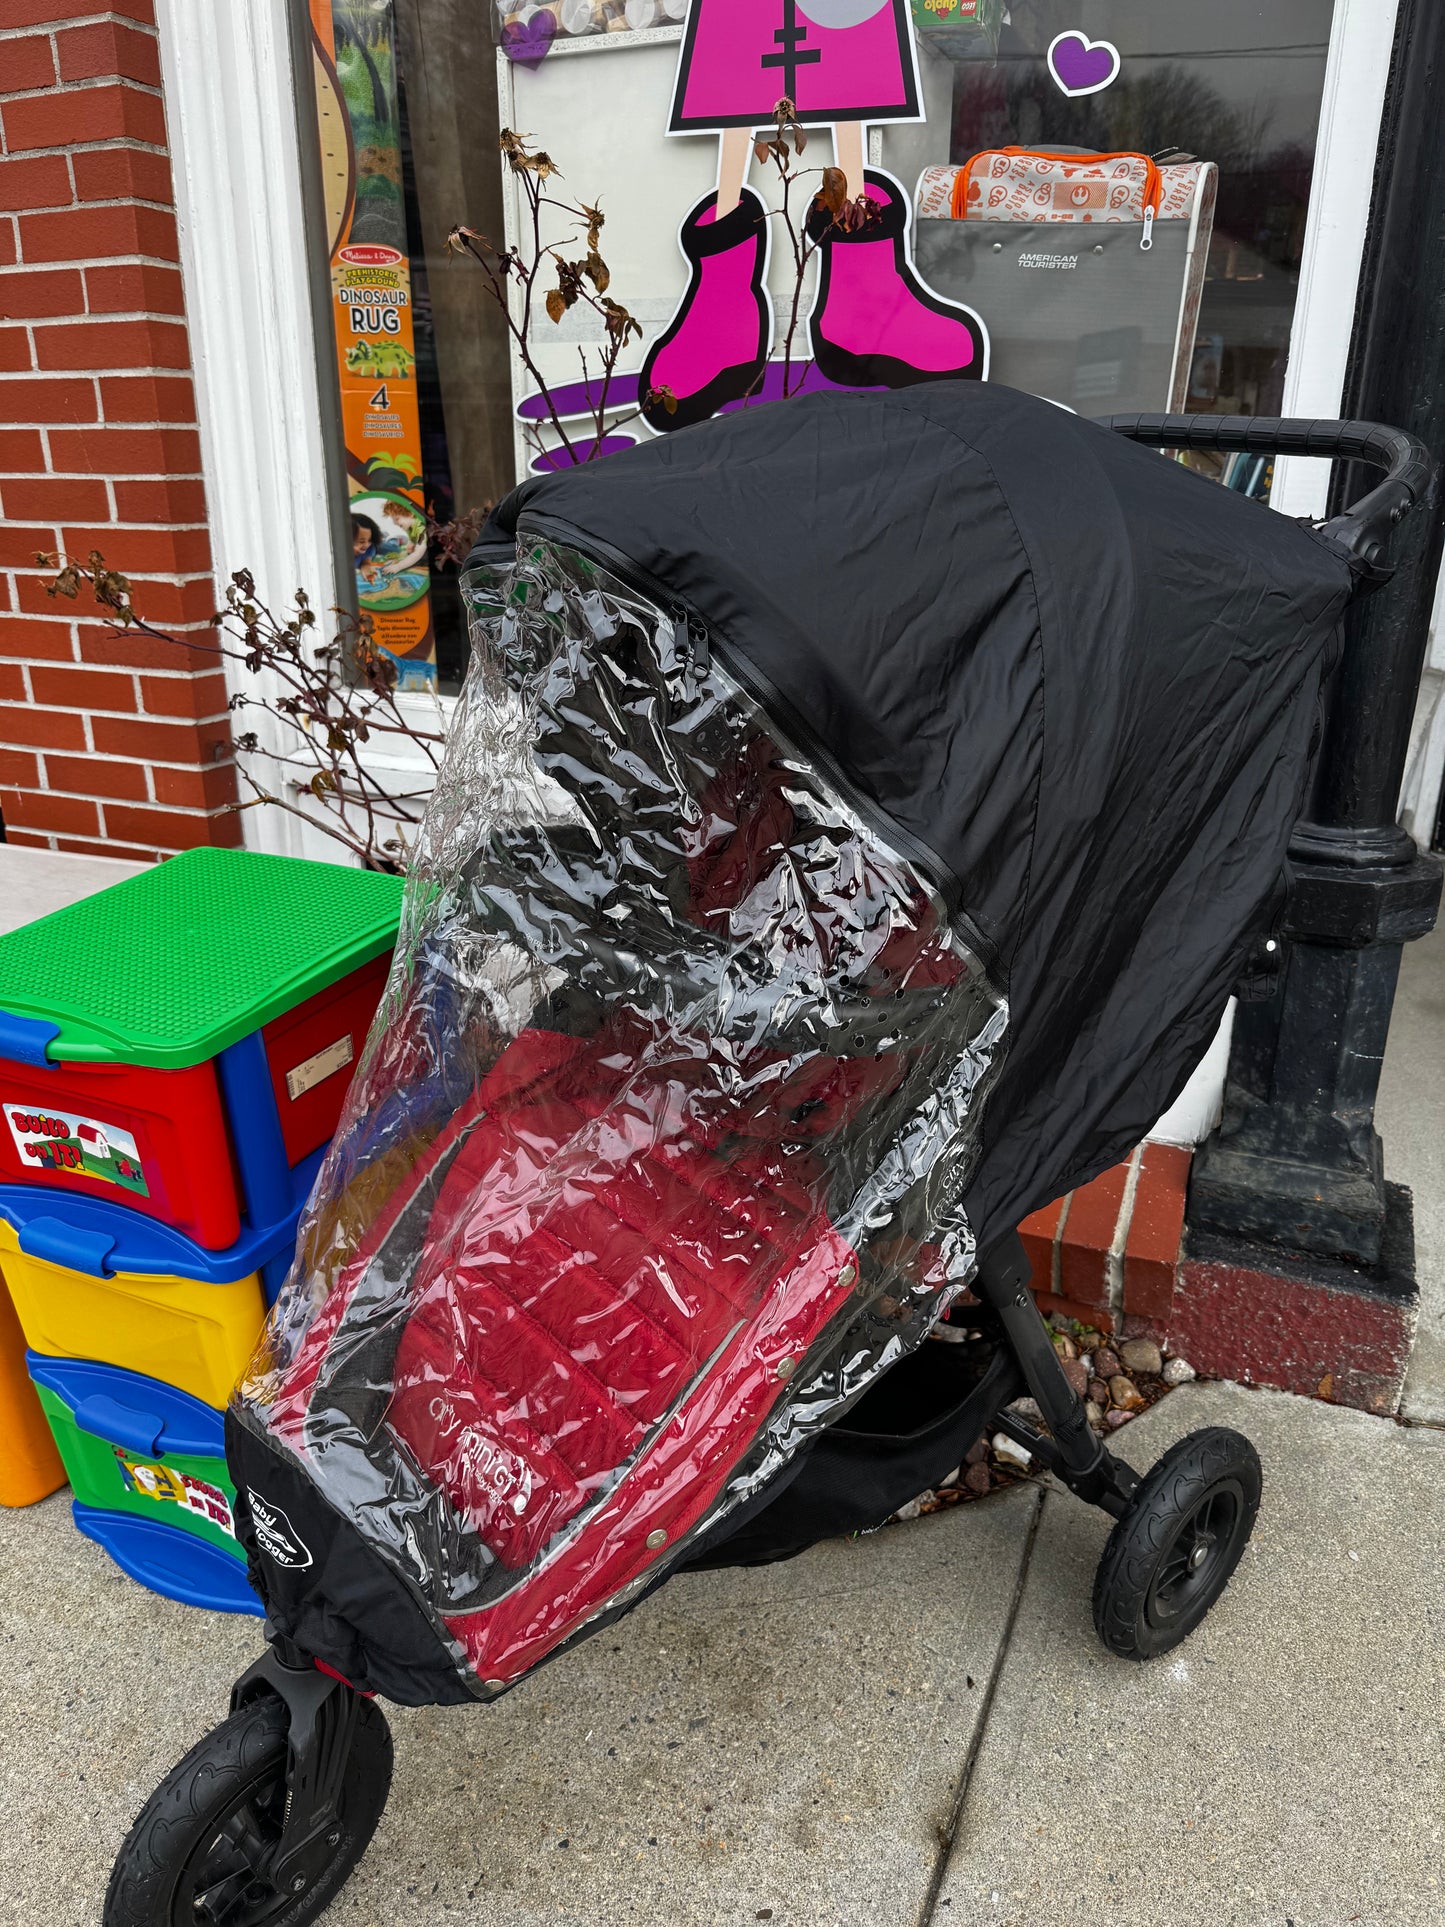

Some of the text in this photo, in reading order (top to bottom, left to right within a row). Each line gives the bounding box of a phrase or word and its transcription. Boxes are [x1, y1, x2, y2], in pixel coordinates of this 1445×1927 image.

[1018, 253, 1078, 263] AMERICAN
[1017, 260, 1077, 269] TOURISTER
[346, 268, 398, 280] PREHISTORIC
[345, 277, 400, 288] PLAYGROUND
[339, 288, 408, 306] DINOSAUR
[350, 306, 401, 334] RUG
[369, 383, 391, 411] 4
